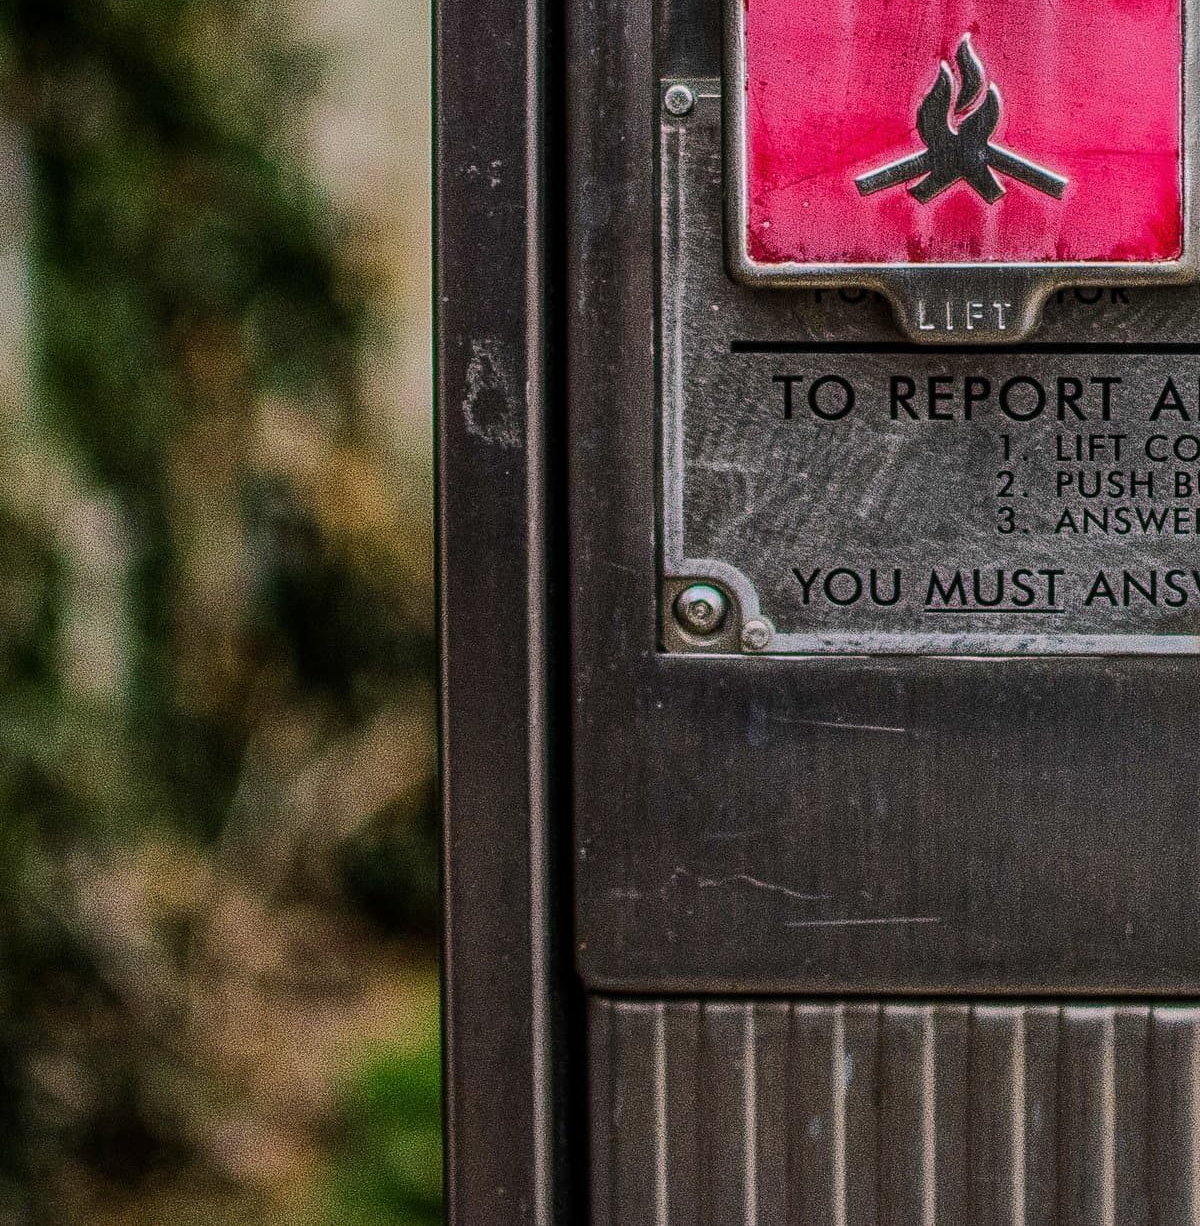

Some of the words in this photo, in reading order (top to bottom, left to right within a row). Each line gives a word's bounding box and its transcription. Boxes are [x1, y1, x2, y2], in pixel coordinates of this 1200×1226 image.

[918, 300, 1012, 331] LIFT
[772, 374, 856, 421] TO
[889, 374, 1123, 422] REPORT
[999, 434, 1029, 462] 1.
[1056, 434, 1127, 462] LIFT
[997, 470, 1029, 498] 2.
[1056, 470, 1154, 499] PUSH
[997, 506, 1029, 534] 3.
[792, 568, 901, 607] YOU
[925, 569, 1064, 611] MUST
